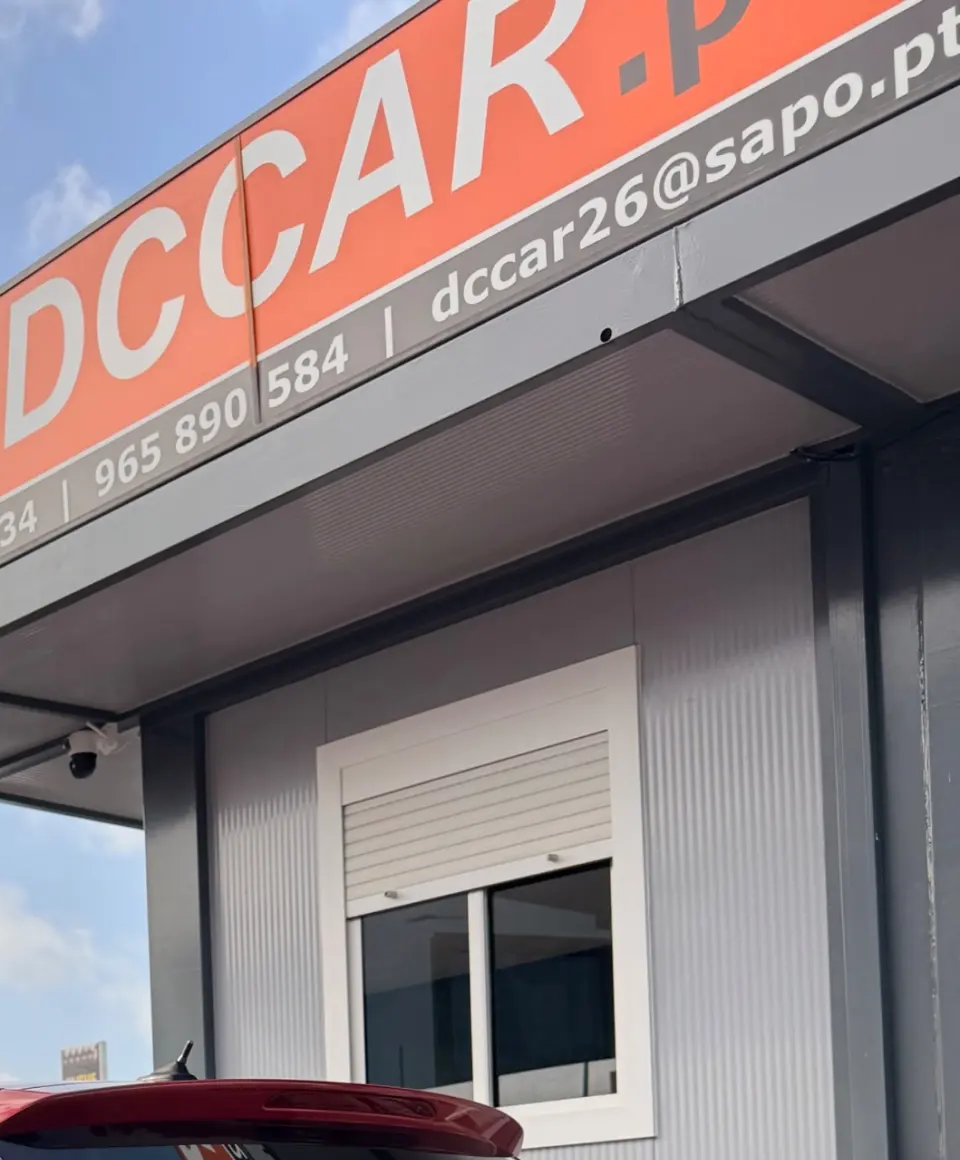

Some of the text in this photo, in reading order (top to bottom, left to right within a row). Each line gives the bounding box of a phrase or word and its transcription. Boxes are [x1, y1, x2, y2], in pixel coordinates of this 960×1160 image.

[94, 432, 161, 497] 965
[175, 387, 246, 453] 890
[268, 334, 349, 408] 584
[431, 6, 960, 322] dccar26@sapo.pt
